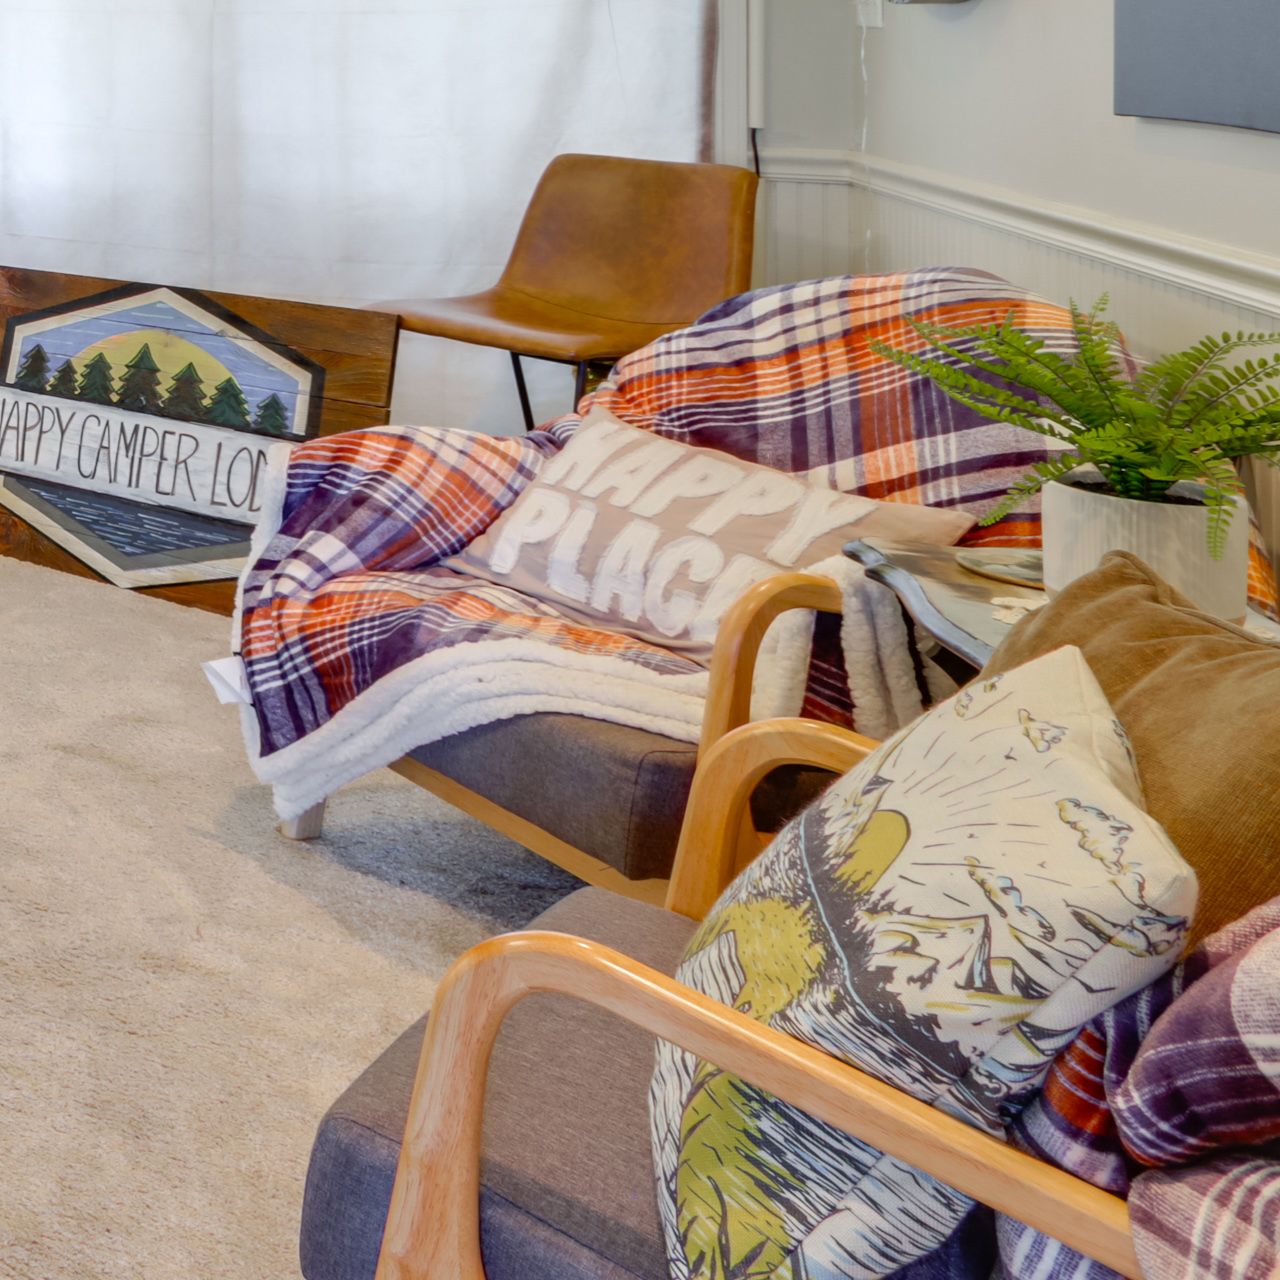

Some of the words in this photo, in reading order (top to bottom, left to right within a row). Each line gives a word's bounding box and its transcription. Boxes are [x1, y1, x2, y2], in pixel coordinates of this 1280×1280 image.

[76, 413, 200, 502] CAMPER
[209, 441, 269, 512] LOD
[539, 419, 878, 568] HAPPY
